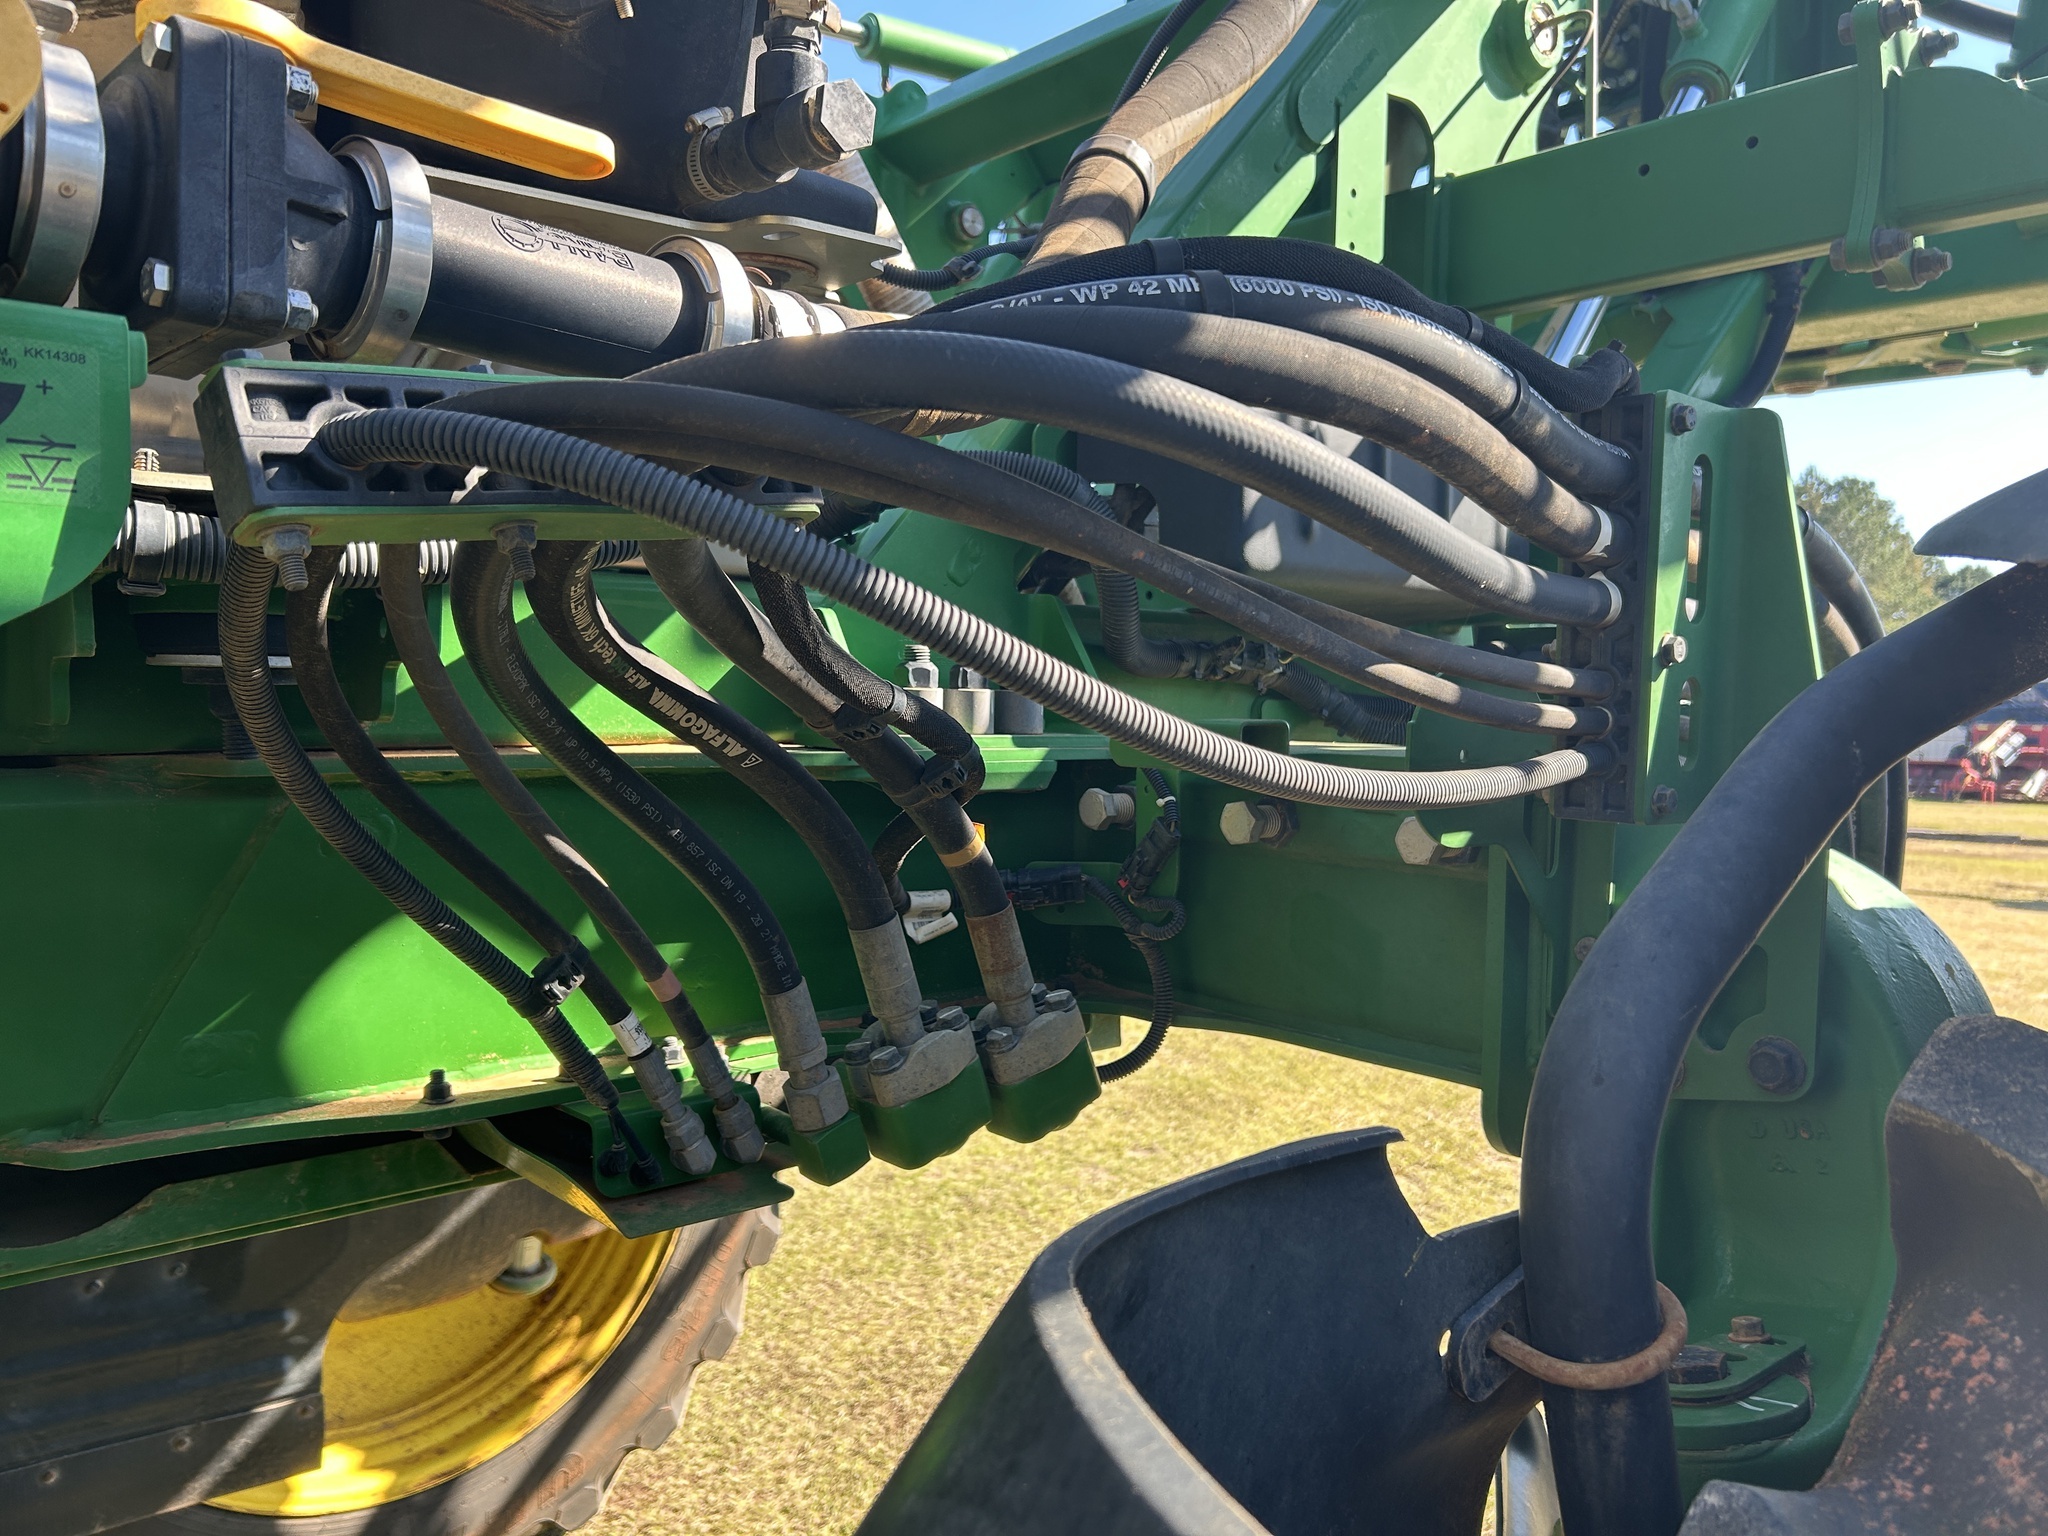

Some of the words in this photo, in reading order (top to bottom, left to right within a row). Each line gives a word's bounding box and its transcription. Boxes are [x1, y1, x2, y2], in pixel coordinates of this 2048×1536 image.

[1069, 283, 1118, 304] WP
[1127, 279, 1161, 296] 42
[1229, 277, 1295, 297] (6000
[1300, 284, 1342, 304] PSI)
[1355, 294, 1392, 315] ISO
[24, 346, 86, 365] KK14308
[580, 622, 600, 642] 6K
[648, 686, 748, 758] ALFAGOMMA
[546, 717, 567, 735] 3/4"
[564, 736, 578, 749] WP
[577, 751, 599, 769] 10.5
[597, 766, 613, 783] MPa
[615, 781, 641, 805] (1530
[640, 802, 663, 823] PSI)
[673, 829, 688, 844] EN
[686, 842, 705, 858] 857
[720, 875, 735, 890] DN
[733, 889, 747, 904] 19
[769, 944, 787, 971] MADE
[781, 973, 793, 989] IN
